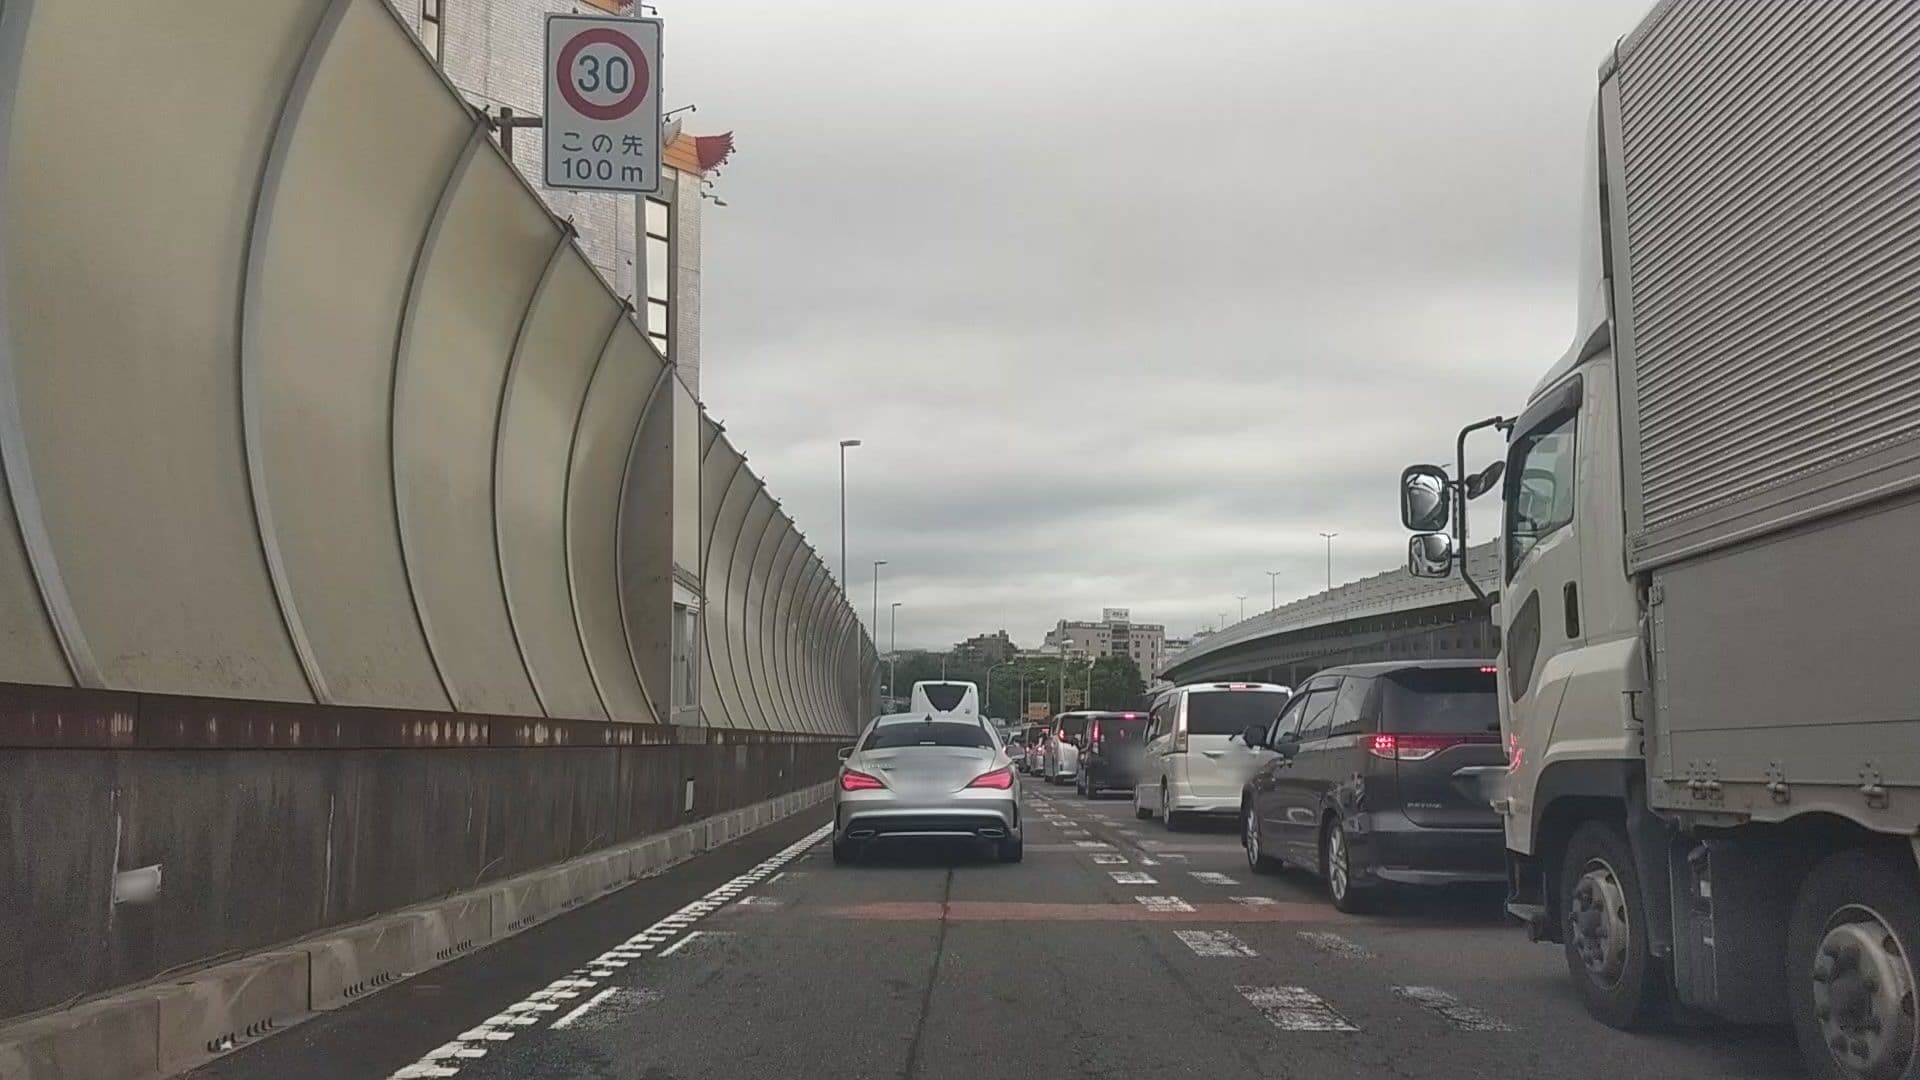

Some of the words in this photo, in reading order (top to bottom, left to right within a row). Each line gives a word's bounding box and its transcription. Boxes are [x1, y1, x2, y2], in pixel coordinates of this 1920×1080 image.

[578, 55, 629, 94] 30
[562, 132, 643, 156] この先
